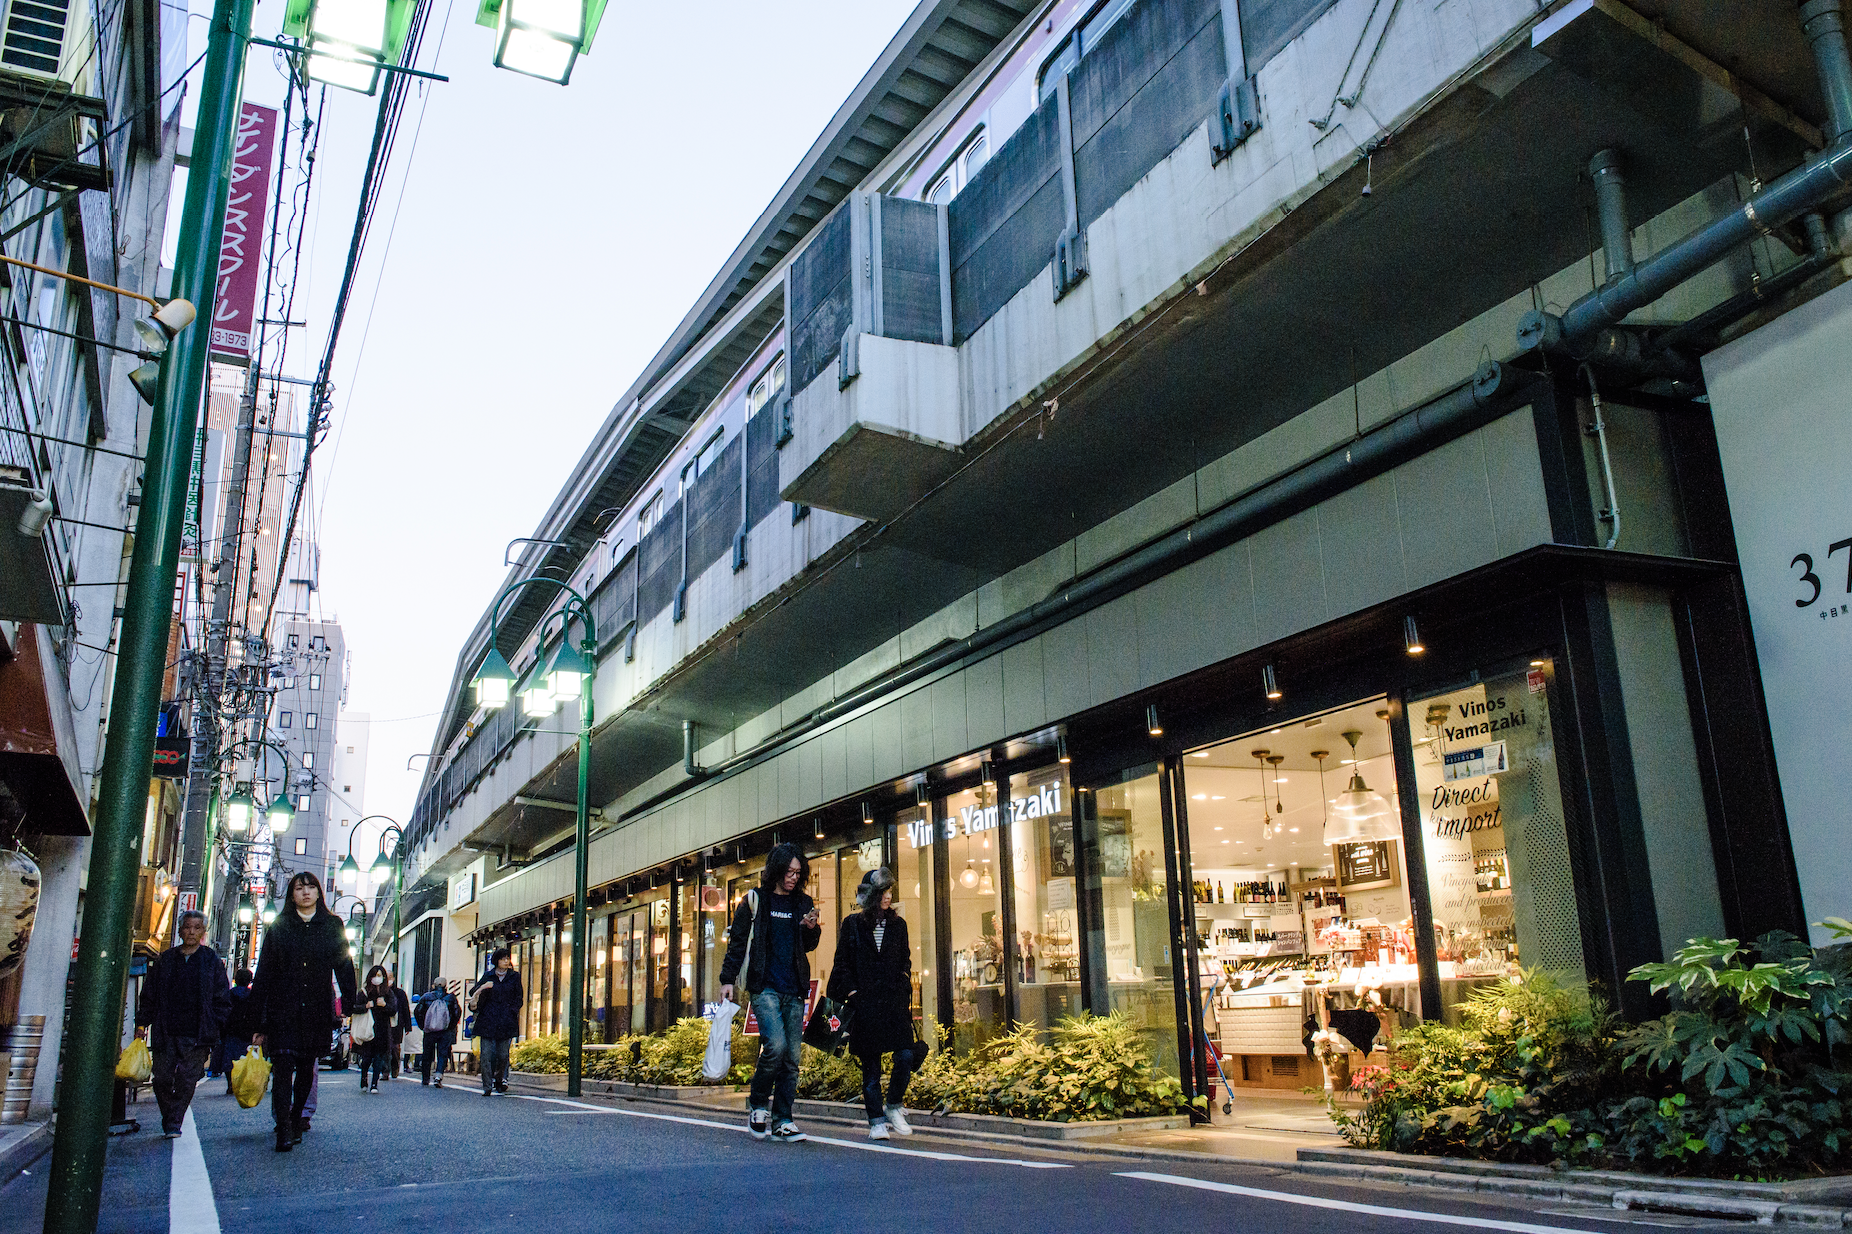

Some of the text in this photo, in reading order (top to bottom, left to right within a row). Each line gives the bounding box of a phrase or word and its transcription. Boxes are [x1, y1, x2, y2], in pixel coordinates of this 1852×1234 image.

[1819, 604, 1849, 621] 中目黒
[1459, 696, 1507, 719] Vinos
[1444, 709, 1527, 742] Yamazaki
[1432, 778, 1492, 811] Direct
[907, 815, 957, 849] Vins
[1436, 804, 1503, 841] import
[1441, 868, 1491, 890] Vineyards
[1445, 890, 1516, 912] and producers
[1447, 911, 1514, 932] are inspected
